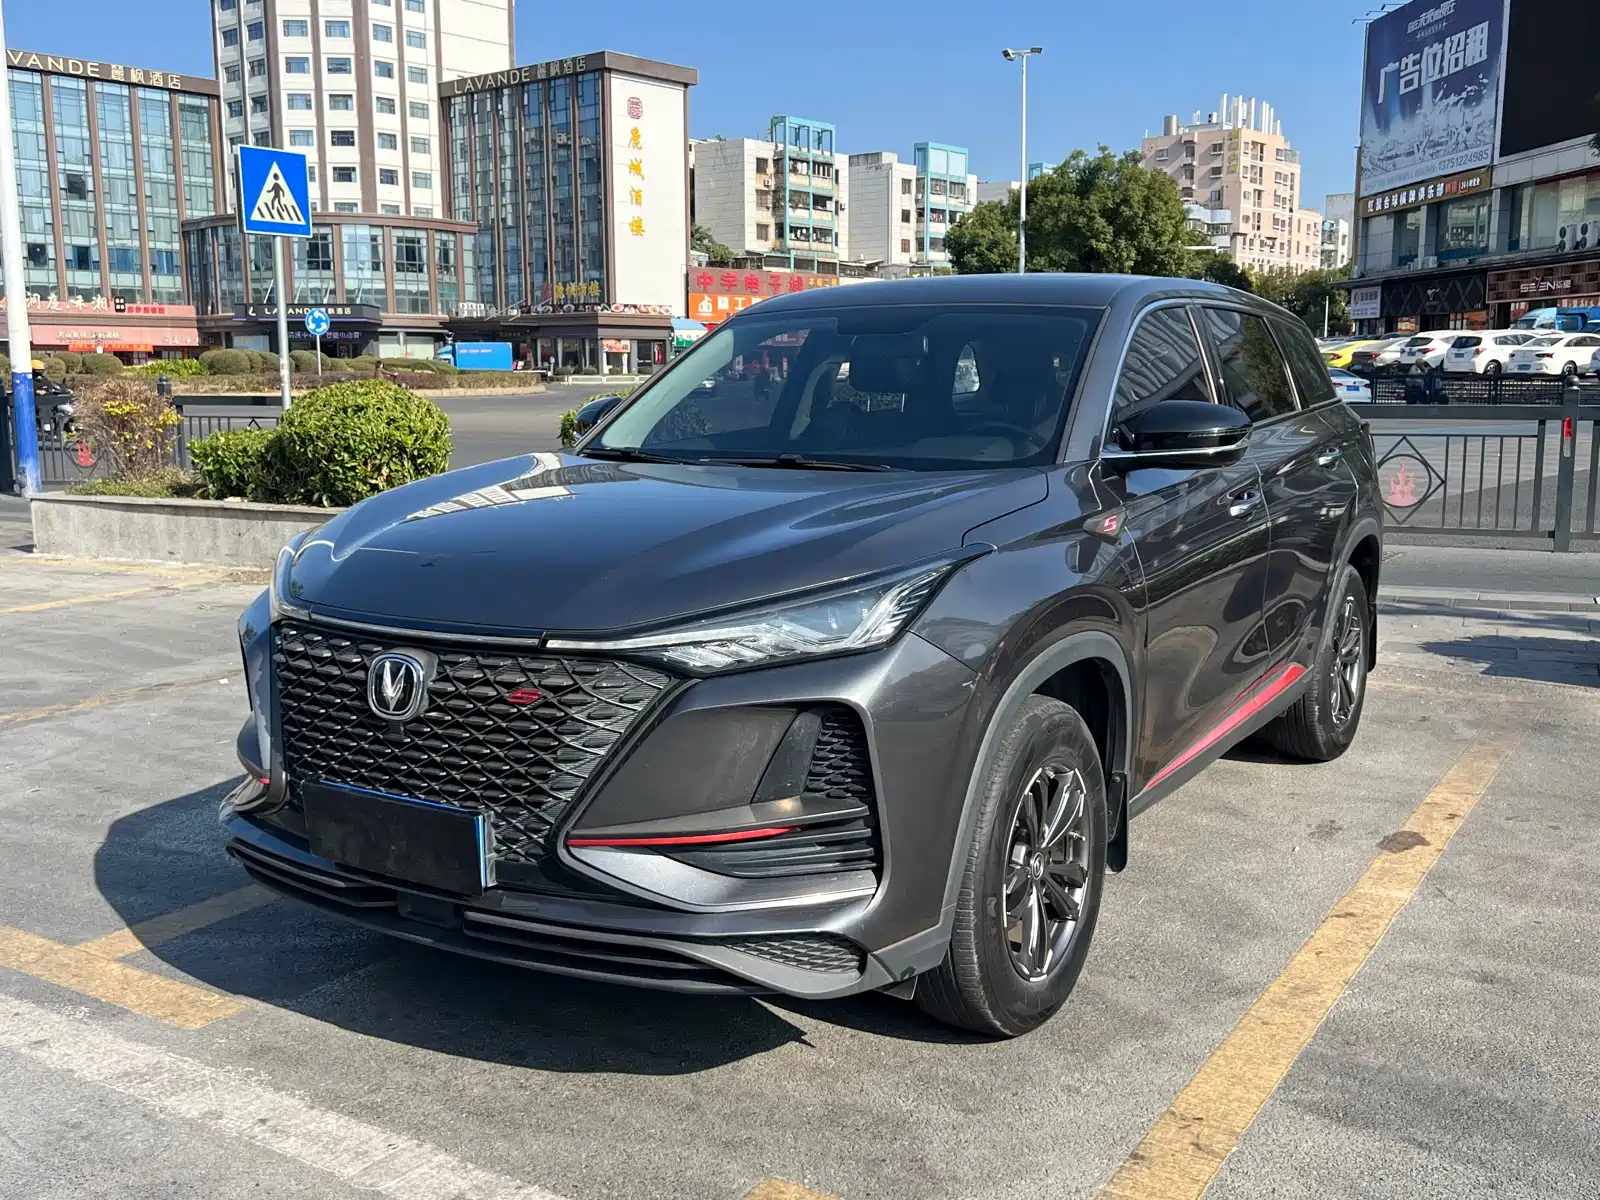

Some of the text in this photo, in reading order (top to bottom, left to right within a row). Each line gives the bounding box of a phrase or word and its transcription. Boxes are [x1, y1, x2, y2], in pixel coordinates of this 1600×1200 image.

[454, 67, 531, 94] LAVANDE
[1378, 20, 1489, 104] 广告位招租
